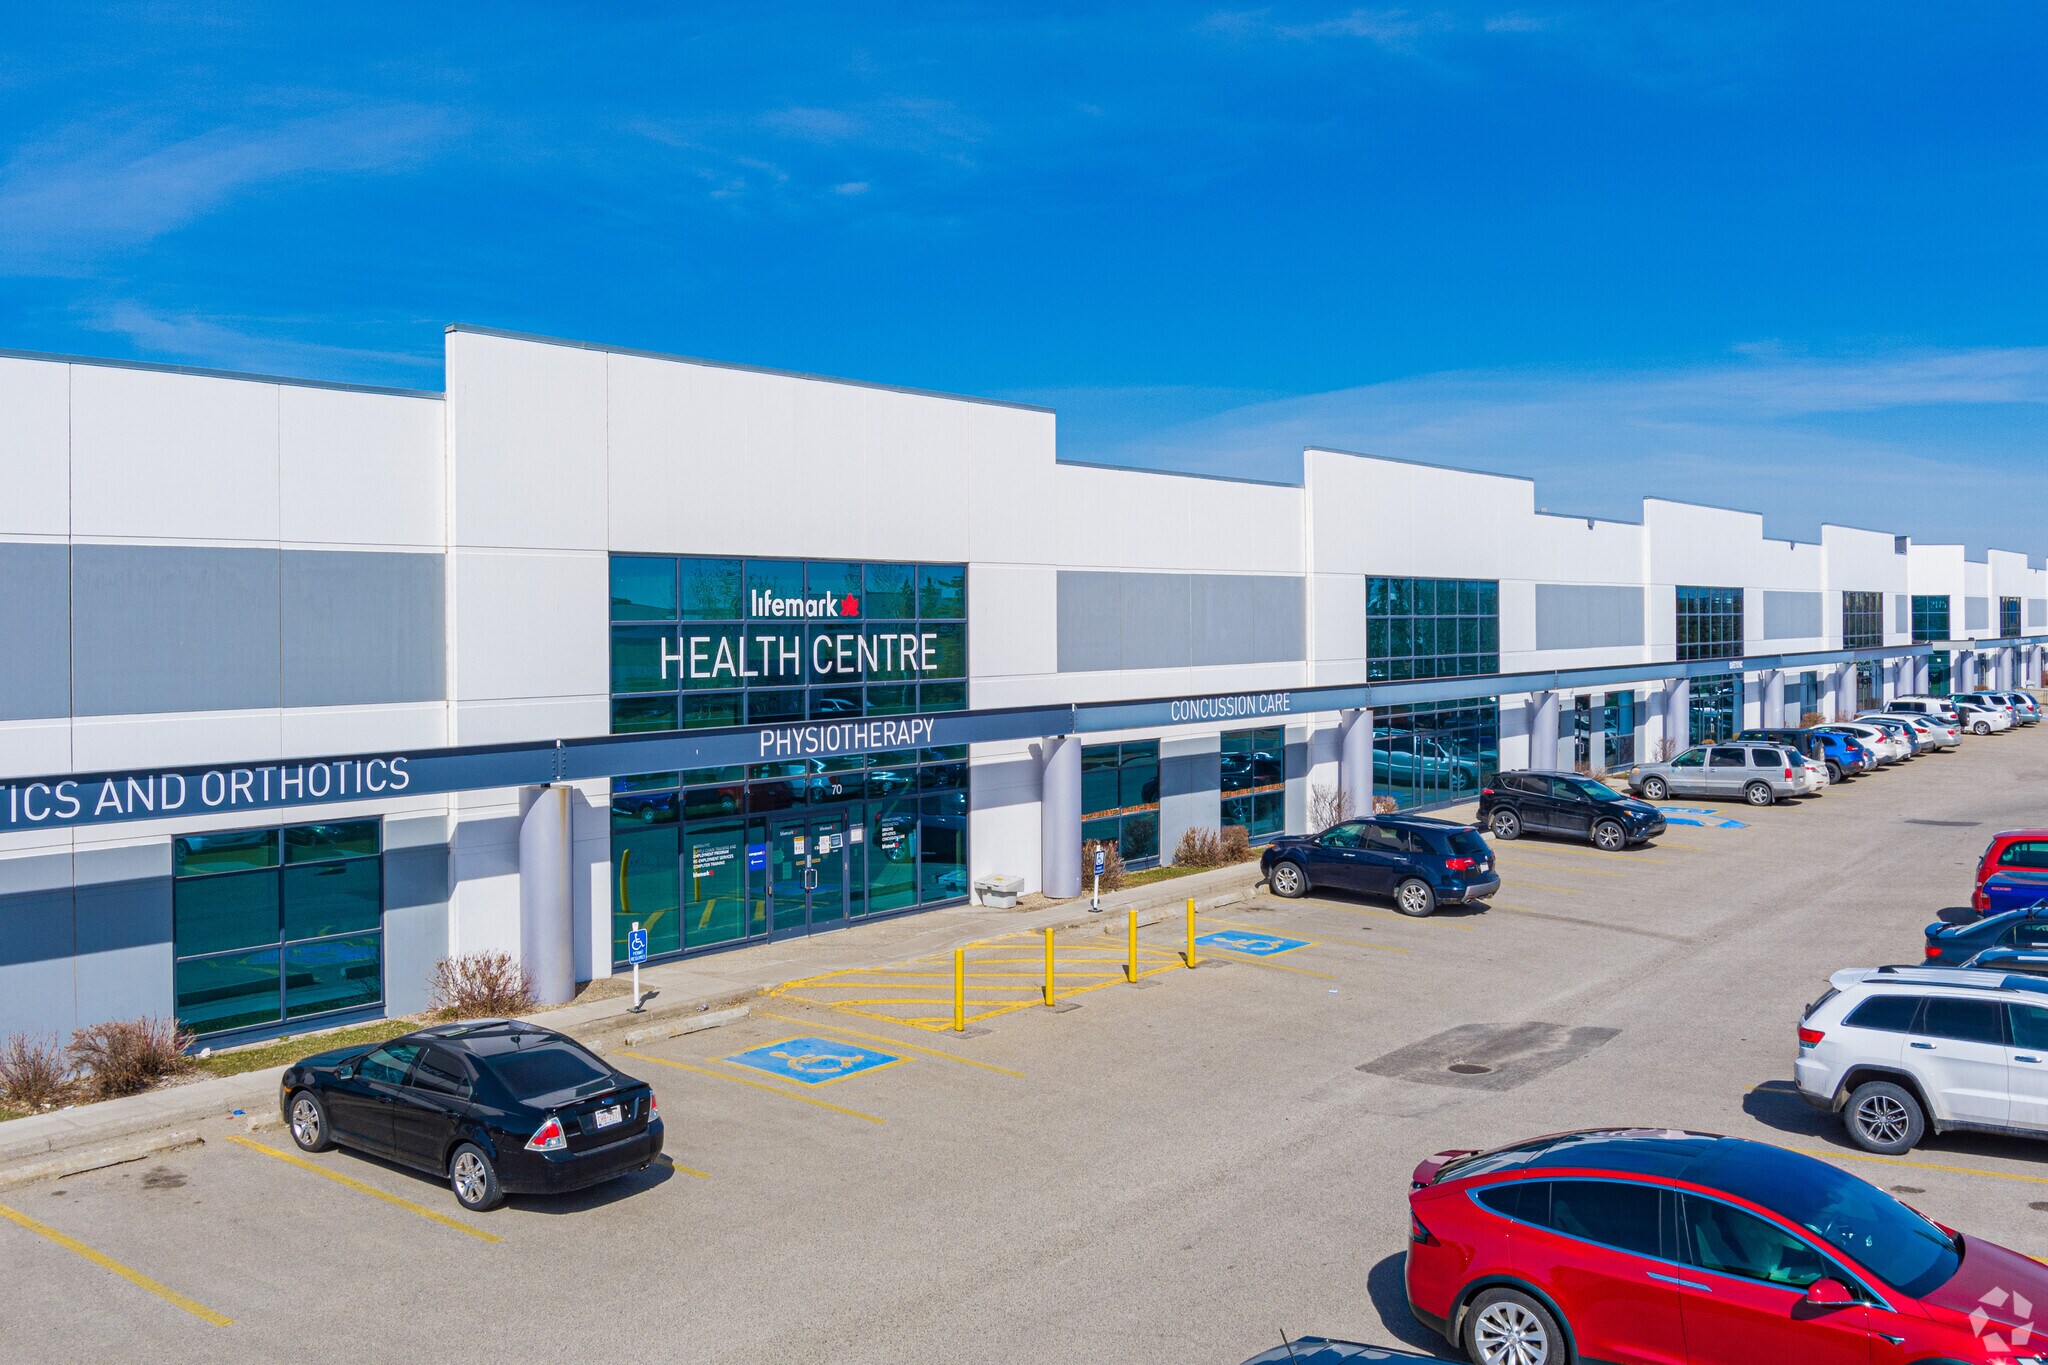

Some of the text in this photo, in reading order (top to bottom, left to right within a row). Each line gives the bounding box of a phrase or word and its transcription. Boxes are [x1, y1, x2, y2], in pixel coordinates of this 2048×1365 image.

[751, 588, 839, 617] lifemark
[660, 633, 938, 679] HEALTH CENTRE
[1171, 692, 1291, 722] CONCUSSION CARE
[760, 718, 935, 757] PHYSIOTHERAPY
[0, 756, 410, 823] ICS AND ORTHOTICS
[832, 784, 843, 795] 70
